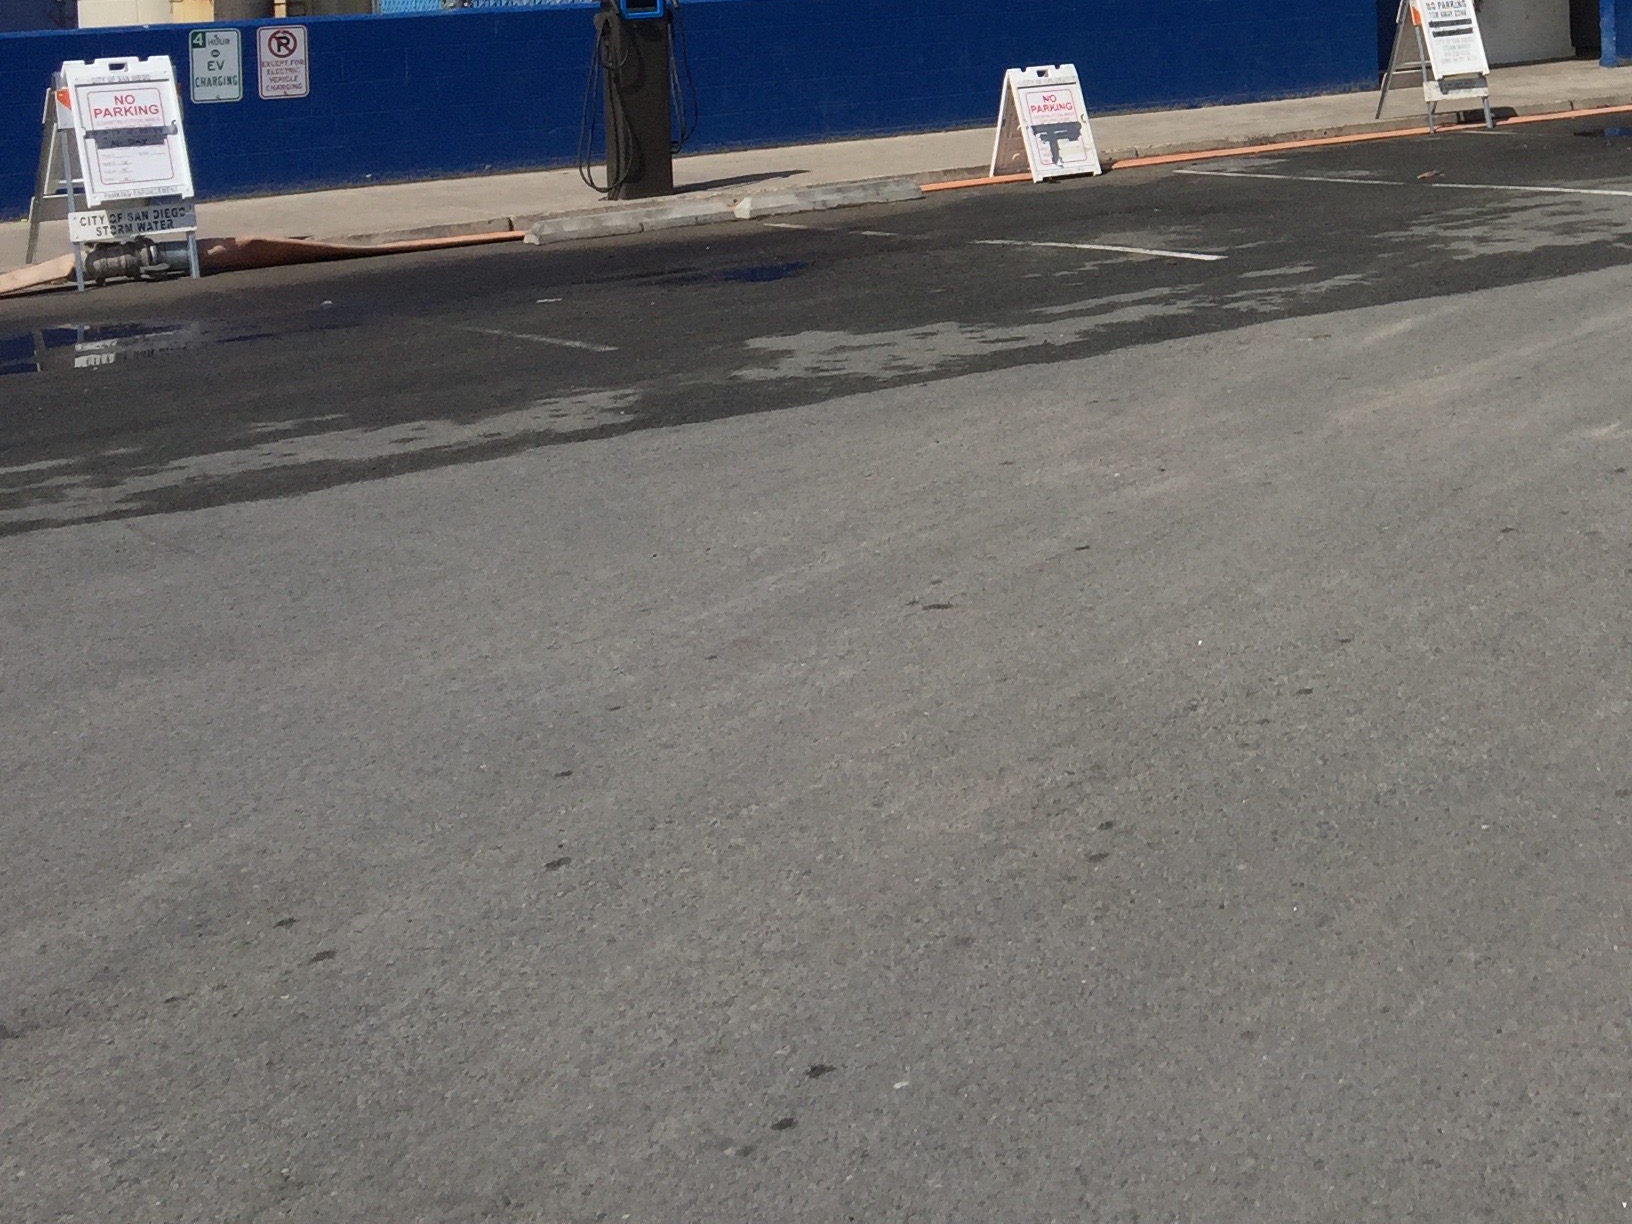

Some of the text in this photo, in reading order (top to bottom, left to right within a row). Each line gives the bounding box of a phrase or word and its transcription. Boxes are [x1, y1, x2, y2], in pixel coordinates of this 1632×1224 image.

[193, 33, 204, 46] 4
[207, 60, 225, 71] EV
[262, 60, 288, 68] EXCEPT
[267, 67, 300, 75] ELECTRIC
[195, 75, 238, 87] CHARGING
[114, 94, 135, 105] NO
[1042, 95, 1057, 103] NO
[93, 104, 160, 118] PARKING
[1031, 102, 1073, 113] PARKING
[80, 207, 186, 226] CITY OF SAN DIEGO
[95, 219, 174, 236] STORM WATER
